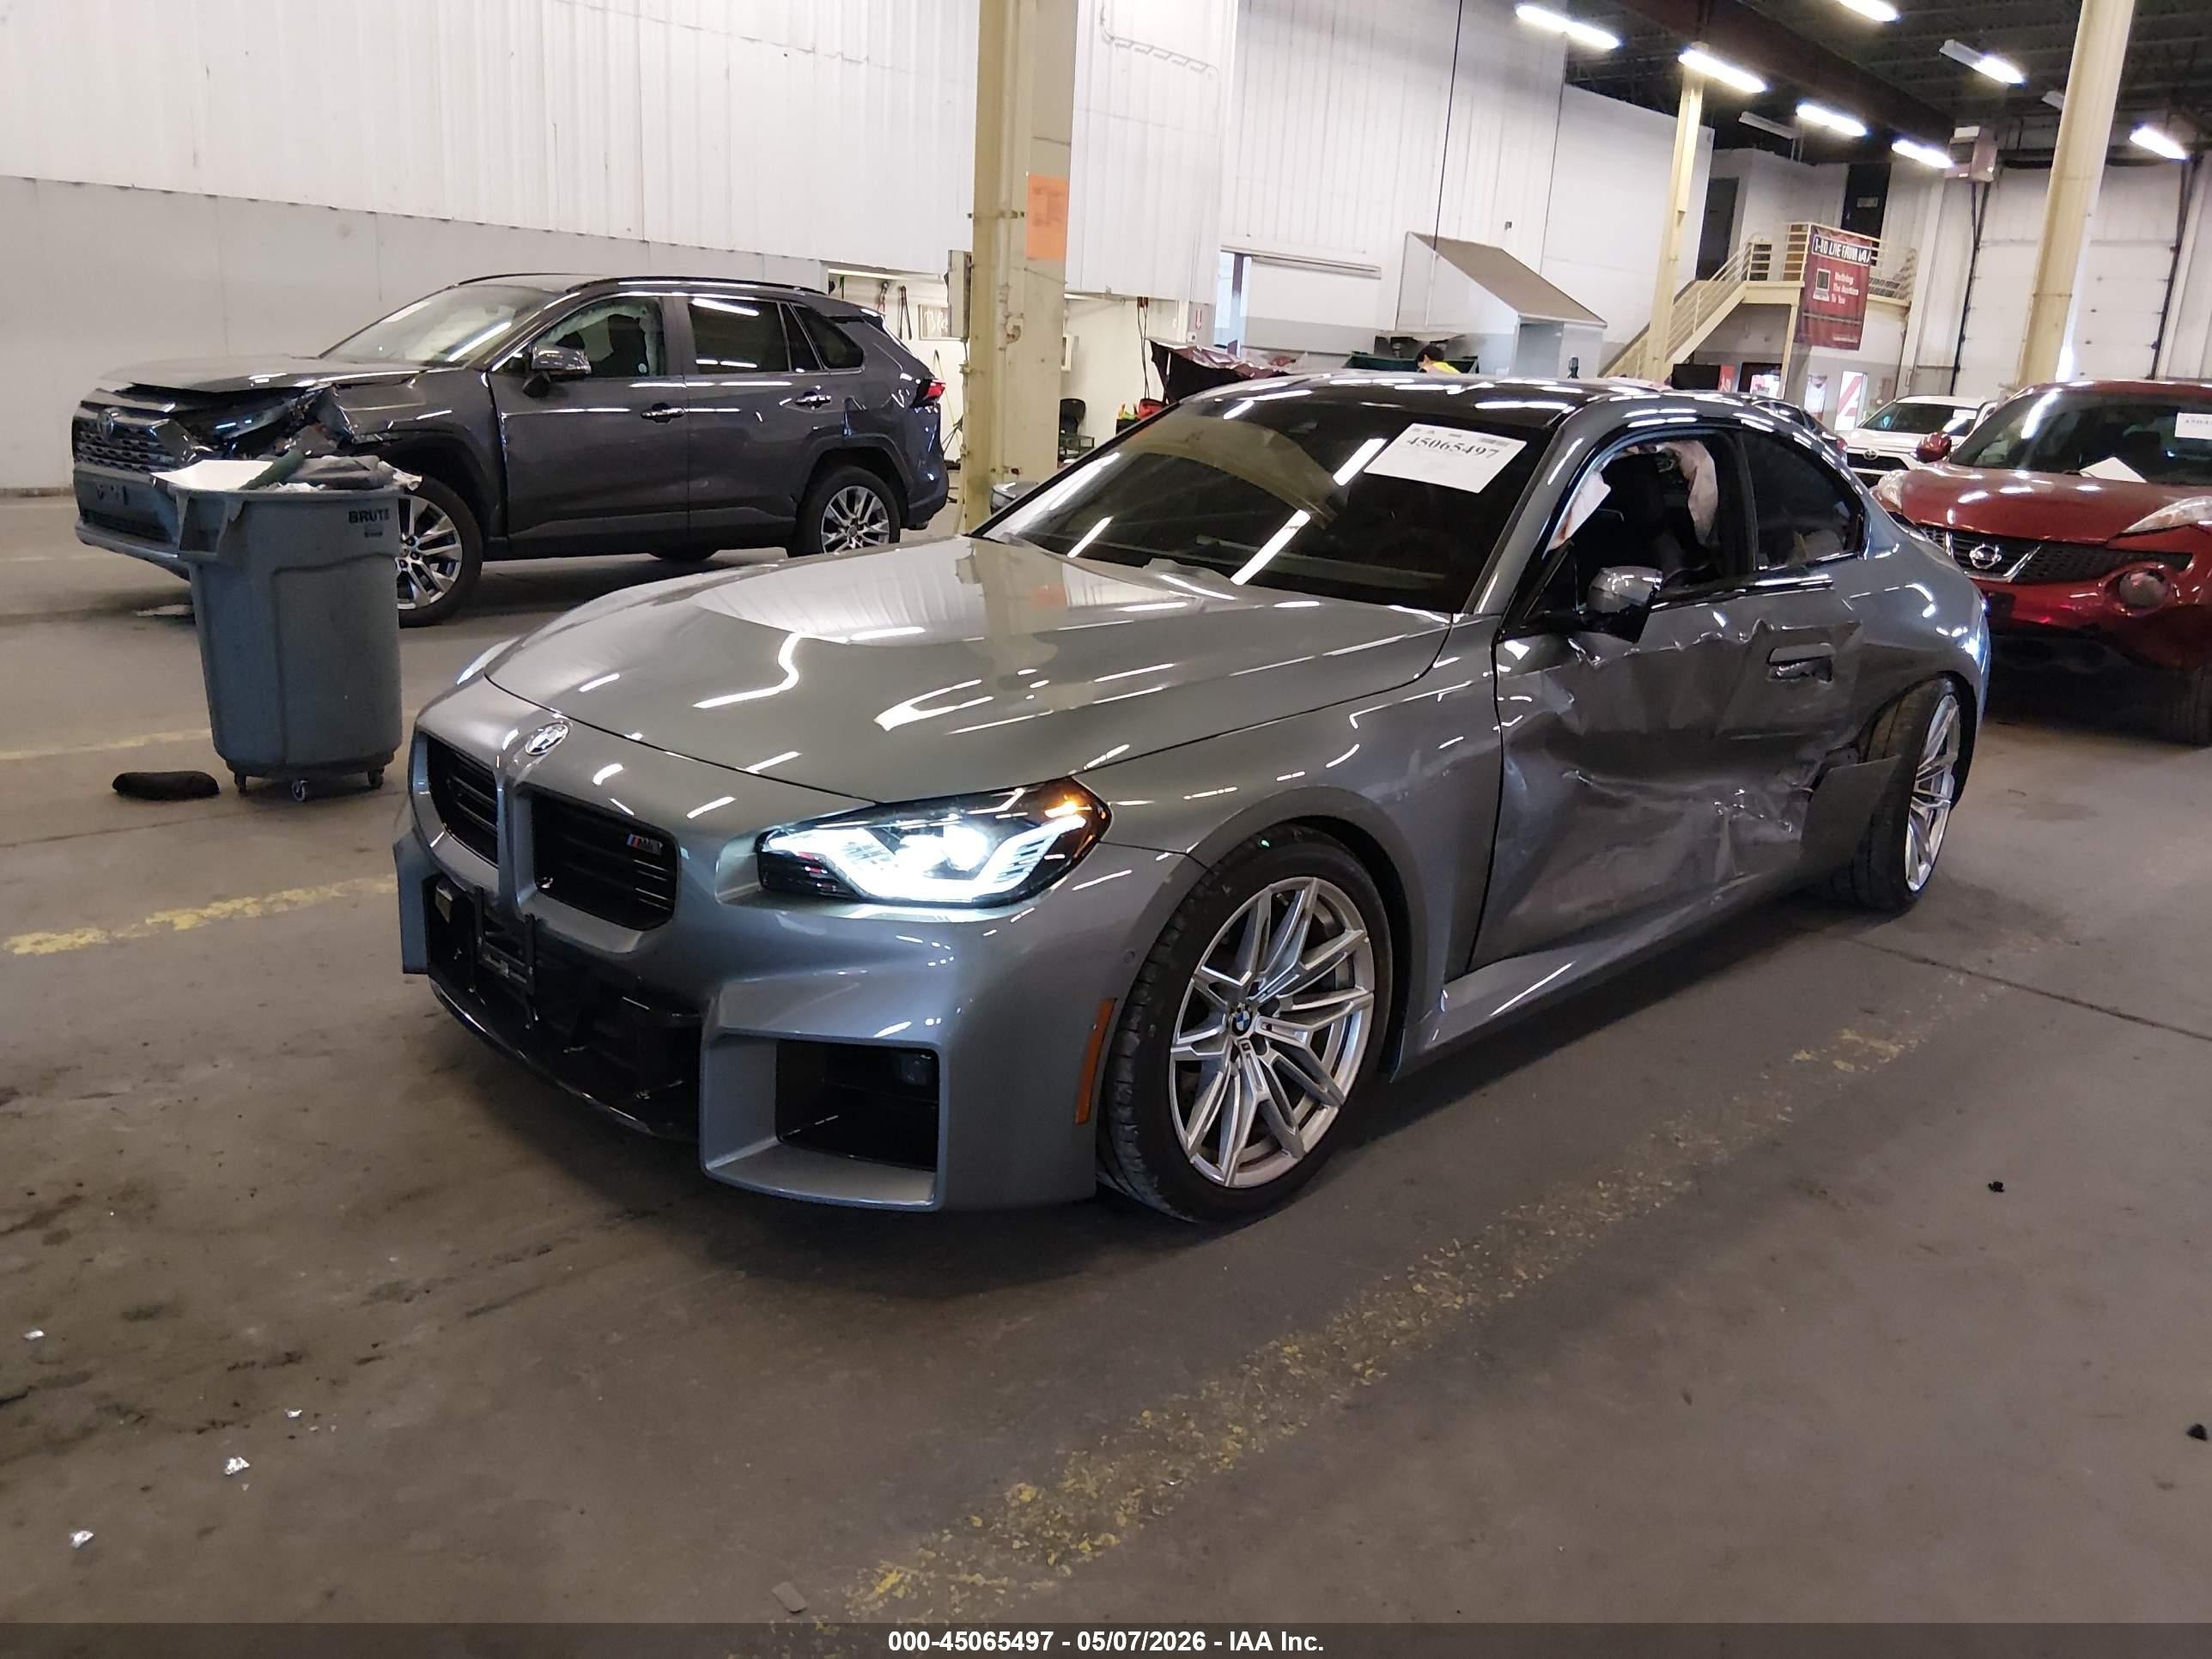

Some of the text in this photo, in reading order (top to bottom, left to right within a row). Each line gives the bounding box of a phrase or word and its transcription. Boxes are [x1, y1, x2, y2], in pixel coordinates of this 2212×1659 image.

[1829, 242, 1841, 257] LIVE
[1842, 245, 1858, 261] FROM
[1407, 436, 1500, 459] 45065497
[349, 507, 390, 524] BRUTE
